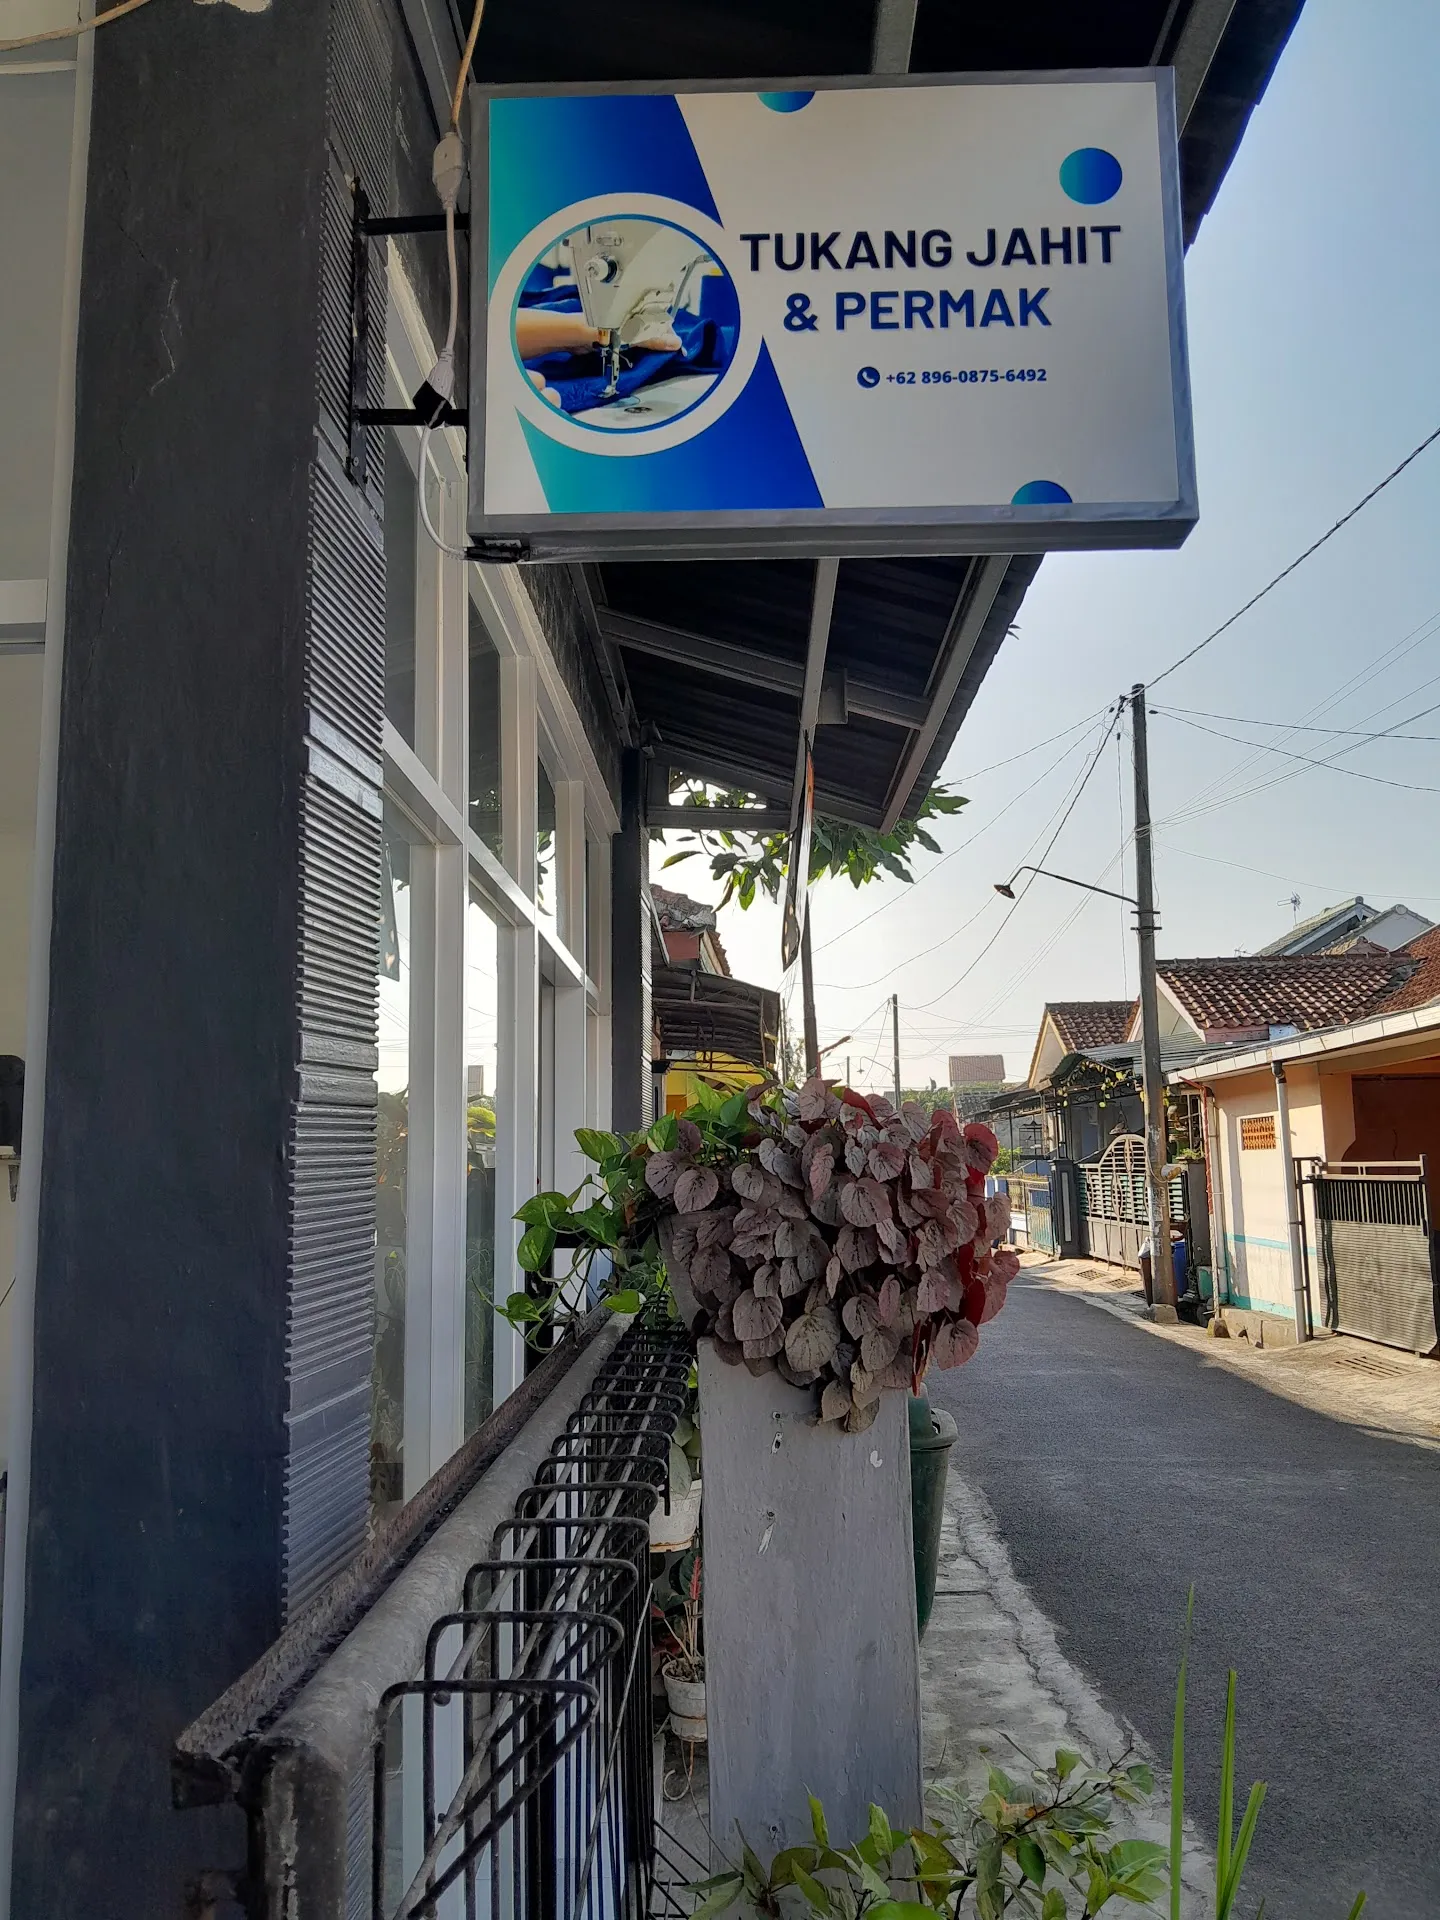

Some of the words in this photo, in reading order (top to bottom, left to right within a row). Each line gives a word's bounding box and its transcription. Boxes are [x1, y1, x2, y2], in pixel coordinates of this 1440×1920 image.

[740, 228, 953, 272] TUKANG
[966, 224, 1122, 269] JAHIT
[783, 291, 819, 333] &
[835, 287, 1053, 331] PERMAK
[885, 371, 917, 385] +62
[921, 368, 1048, 385] 896-0875-6492
